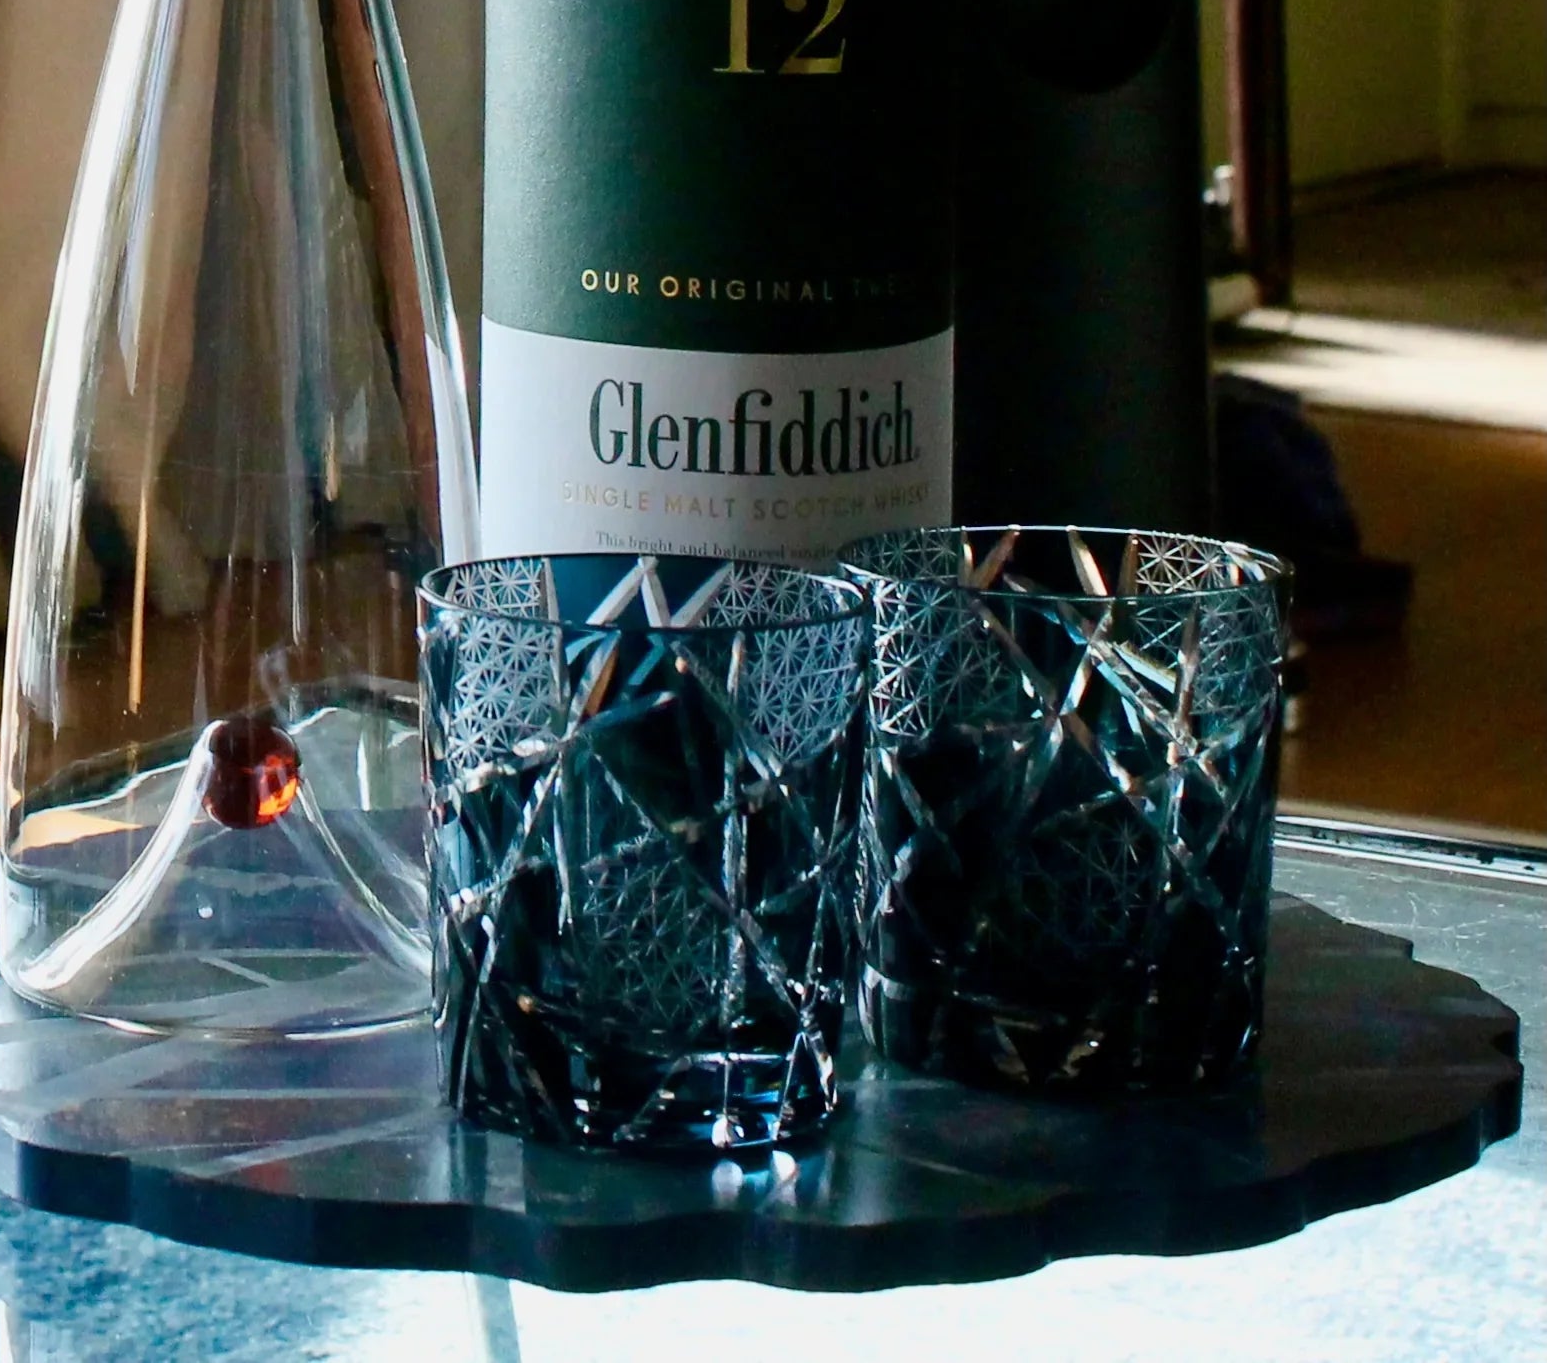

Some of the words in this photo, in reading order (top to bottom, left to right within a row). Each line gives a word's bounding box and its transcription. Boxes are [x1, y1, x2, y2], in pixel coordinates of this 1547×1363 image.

[580, 268, 640, 296] OUR
[659, 275, 835, 303] ORIGINAL
[589, 378, 917, 478] Glenfiddich
[563, 480, 650, 512] SINGLE
[664, 493, 735, 518] MALT
[753, 496, 865, 520] SCOTCH
[595, 530, 626, 548] This
[628, 535, 673, 554] bright
[679, 542, 708, 557] and
